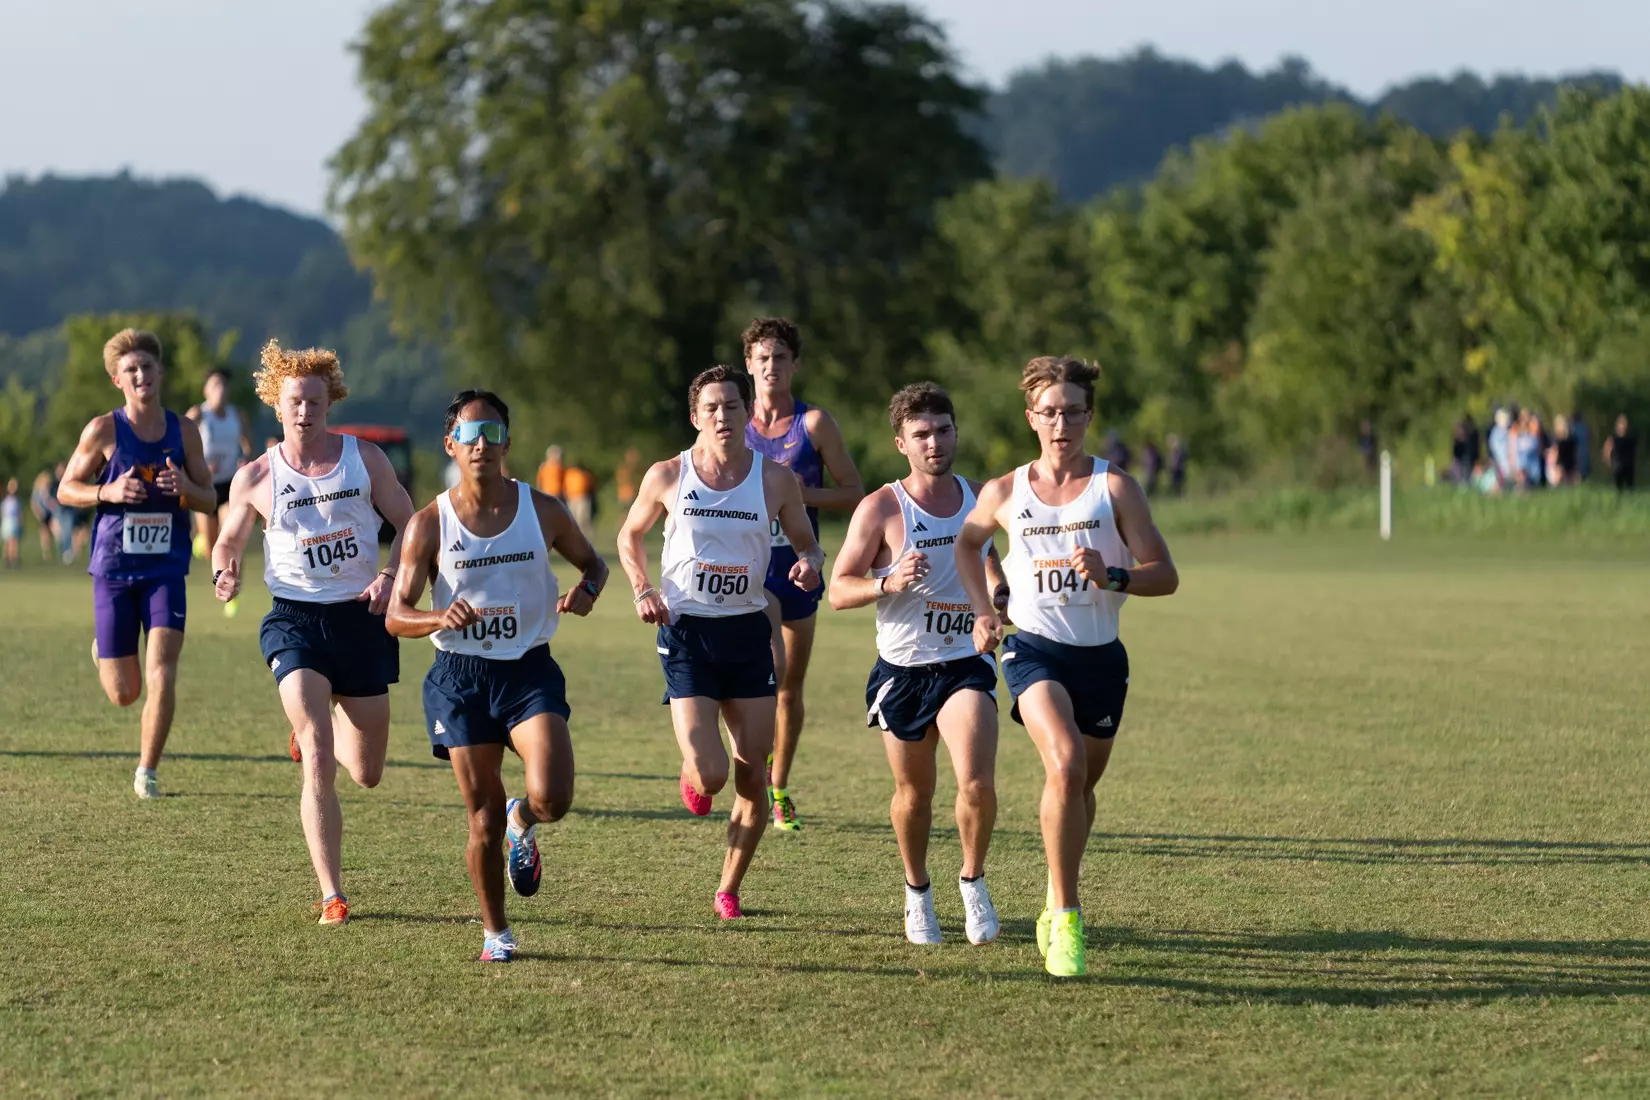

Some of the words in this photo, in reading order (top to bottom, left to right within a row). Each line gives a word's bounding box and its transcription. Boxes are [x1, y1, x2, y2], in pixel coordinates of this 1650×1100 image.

[287, 488, 360, 510] CHATTANOOGA
[683, 507, 758, 521] CHATTANOOGA
[127, 525, 170, 543] 1072
[301, 527, 353, 547] TENNESSEE
[1022, 519, 1100, 537] CHATTANOOGA
[916, 535, 957, 549] CHATTA
[303, 537, 358, 569] 1045
[454, 551, 535, 570] CHATTANOOGA
[697, 562, 748, 574] TENNESSEE
[1033, 558, 1071, 569] TENNES
[696, 572, 749, 595] 1050
[923, 610, 975, 635] 1046
